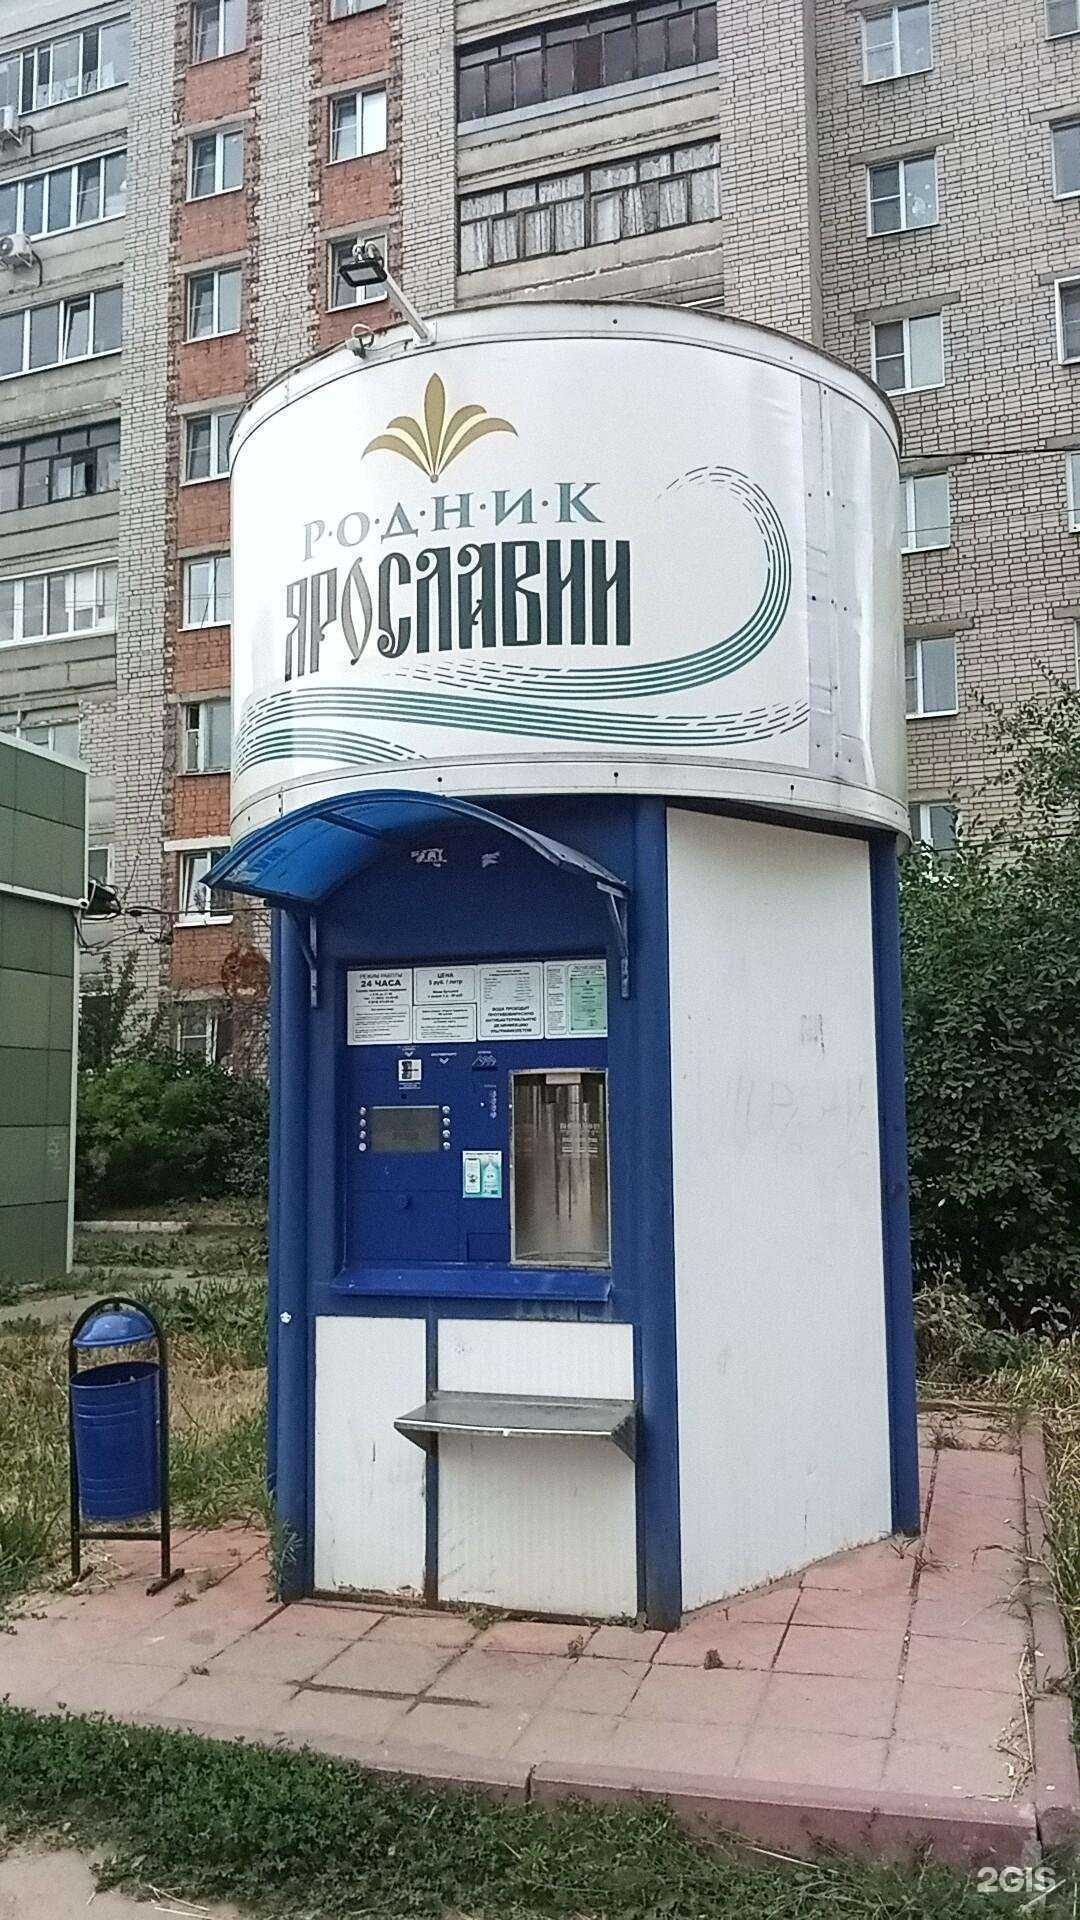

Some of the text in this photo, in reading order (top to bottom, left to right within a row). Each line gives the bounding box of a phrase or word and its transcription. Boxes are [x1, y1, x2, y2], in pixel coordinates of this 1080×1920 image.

[285, 539, 631, 682] ЯРОСЛАВИИ
[360, 979, 401, 988] 24 ЧАСА
